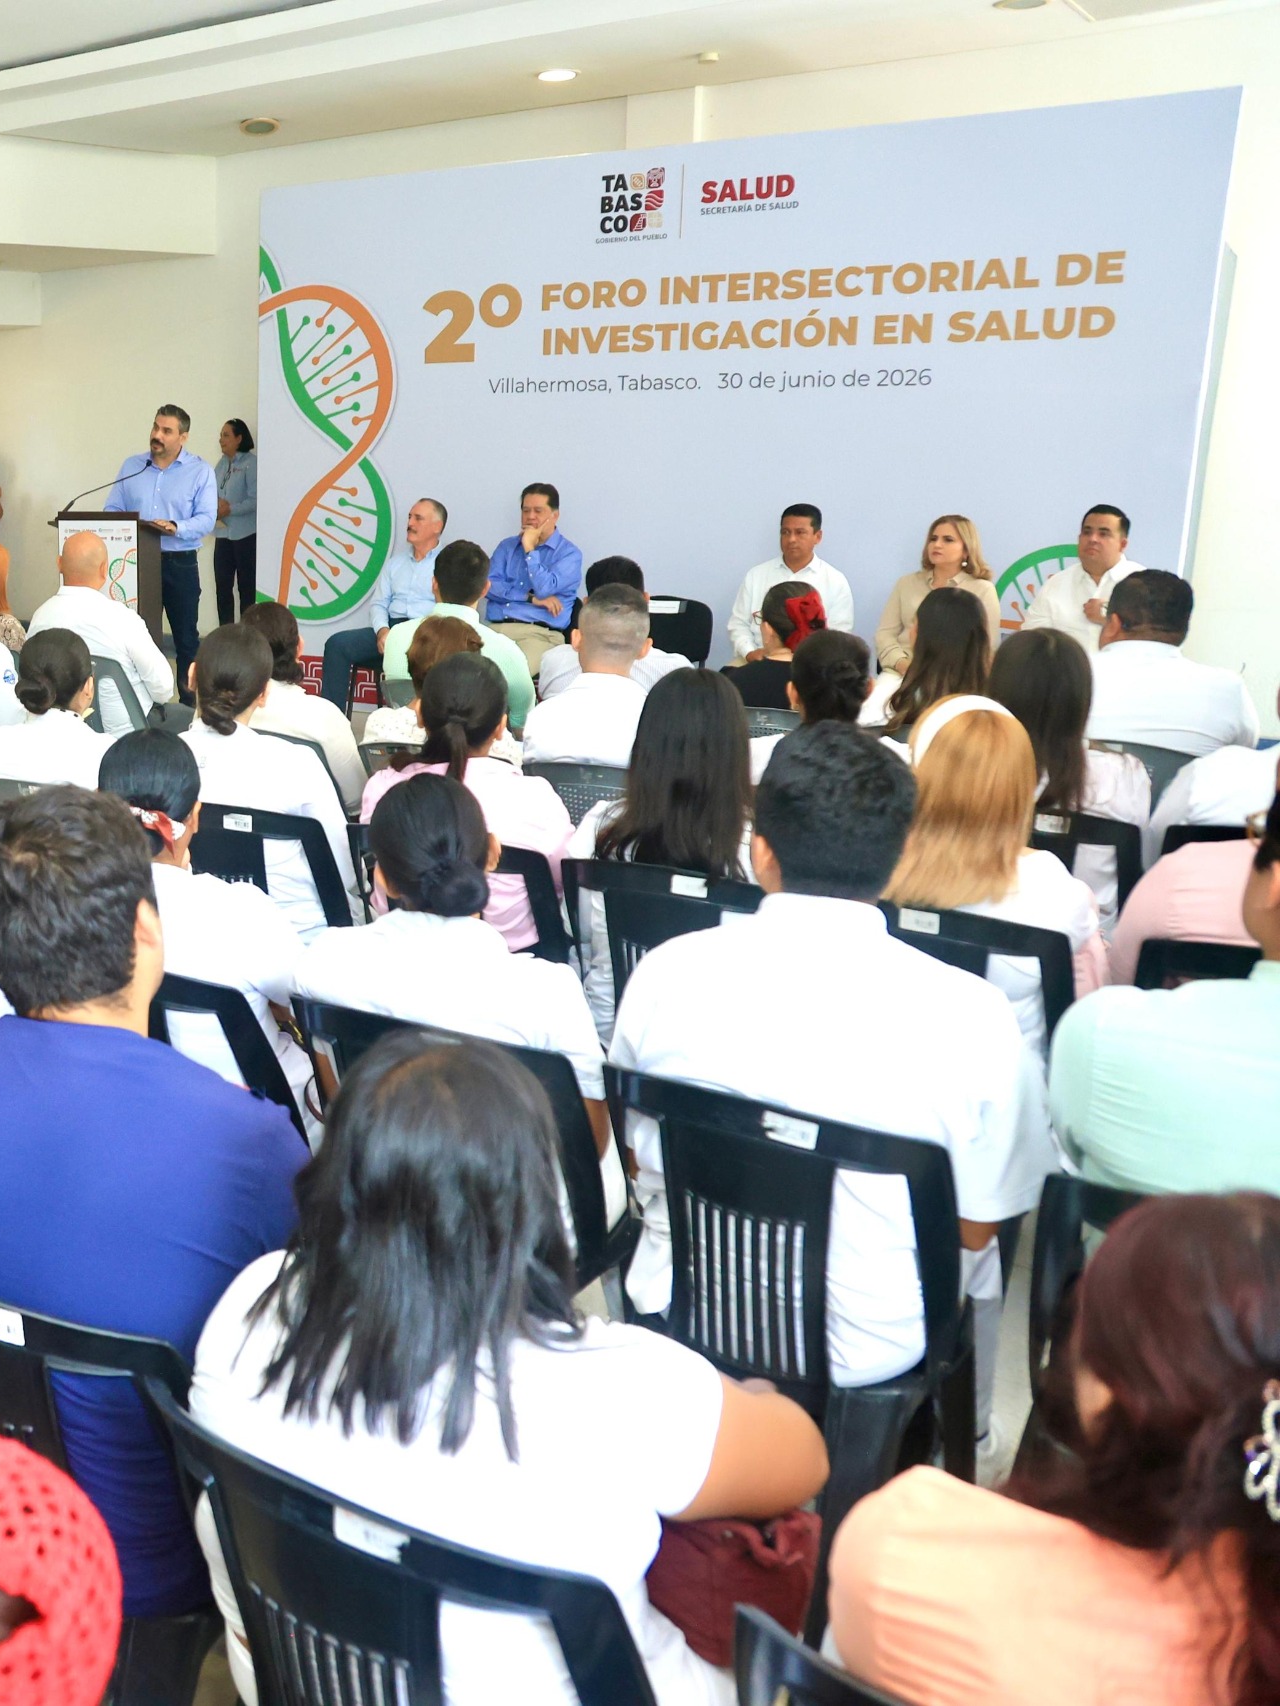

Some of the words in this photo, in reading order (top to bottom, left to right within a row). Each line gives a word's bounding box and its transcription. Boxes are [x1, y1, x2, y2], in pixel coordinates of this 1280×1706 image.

[601, 173, 628, 193] TA
[700, 174, 795, 204] SALUD
[600, 193, 643, 214] BAS
[700, 203, 753, 216] SECRETARÍA
[754, 203, 767, 212] DE
[769, 201, 799, 211] SALUD
[600, 214, 628, 234] CO
[595, 235, 628, 244] GOBIERNO
[642, 233, 668, 241] PUEBLO
[541, 278, 648, 312] FORO
[659, 256, 1040, 306] INTERSECTORIAL
[1055, 250, 1127, 287] DE
[542, 308, 859, 356] INVESTIGACIÓN
[873, 312, 934, 345] EN
[947, 305, 1116, 344] SALUD
[488, 377, 612, 394] Villahermosa,
[617, 374, 701, 391] Tabasco.
[717, 372, 743, 389] 30
[748, 371, 776, 389] de
[778, 370, 836, 393] junio
[842, 369, 871, 388] de
[876, 368, 932, 387] 2026
